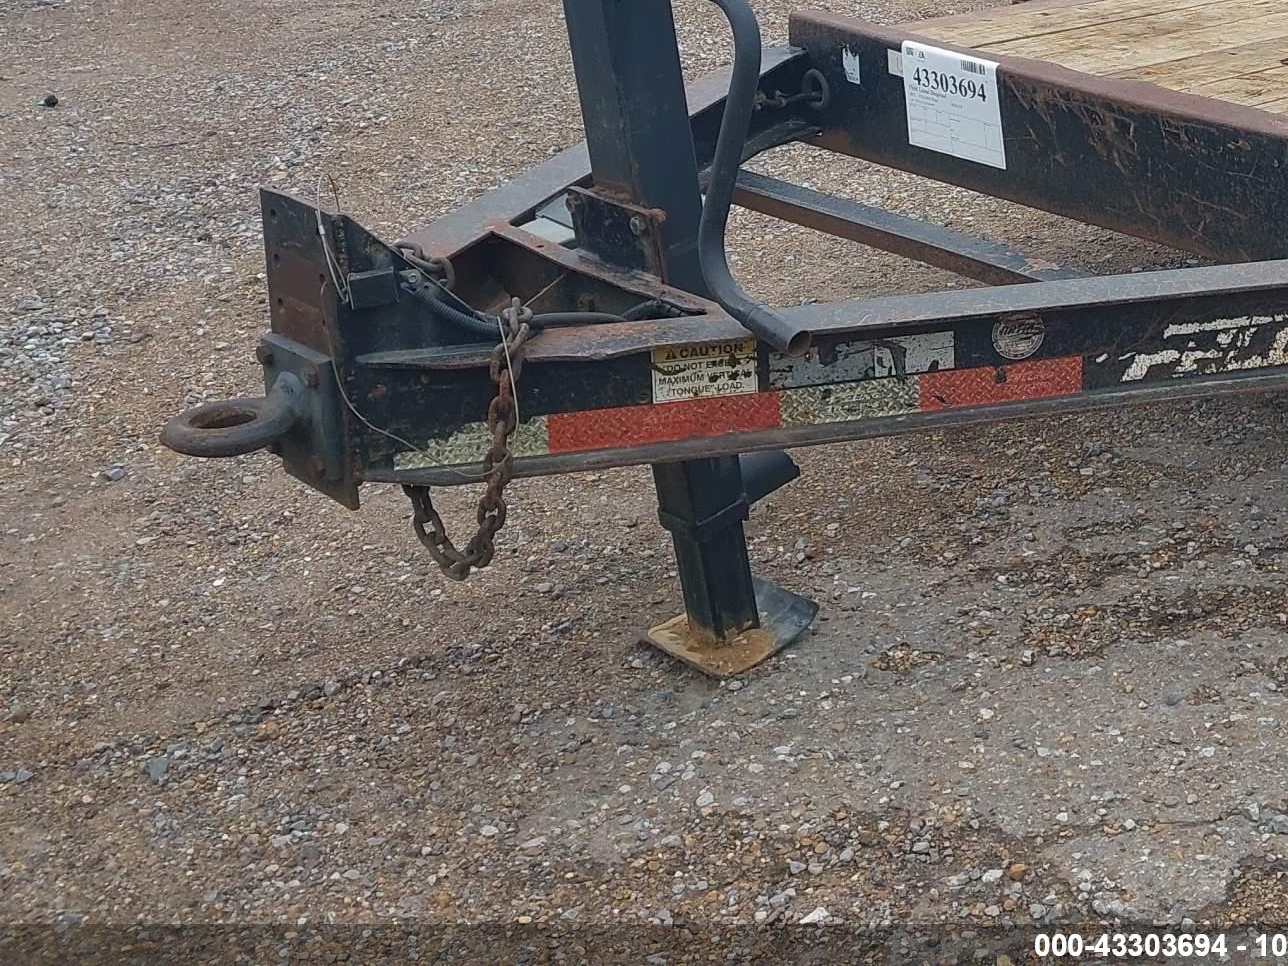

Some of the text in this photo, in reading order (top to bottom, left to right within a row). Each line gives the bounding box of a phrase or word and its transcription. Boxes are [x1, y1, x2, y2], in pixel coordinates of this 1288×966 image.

[913, 67, 986, 102] 43303694
[680, 343, 743, 359] CAUTION
[684, 361, 703, 371] NOT
[658, 372, 705, 385] MAXIMUM
